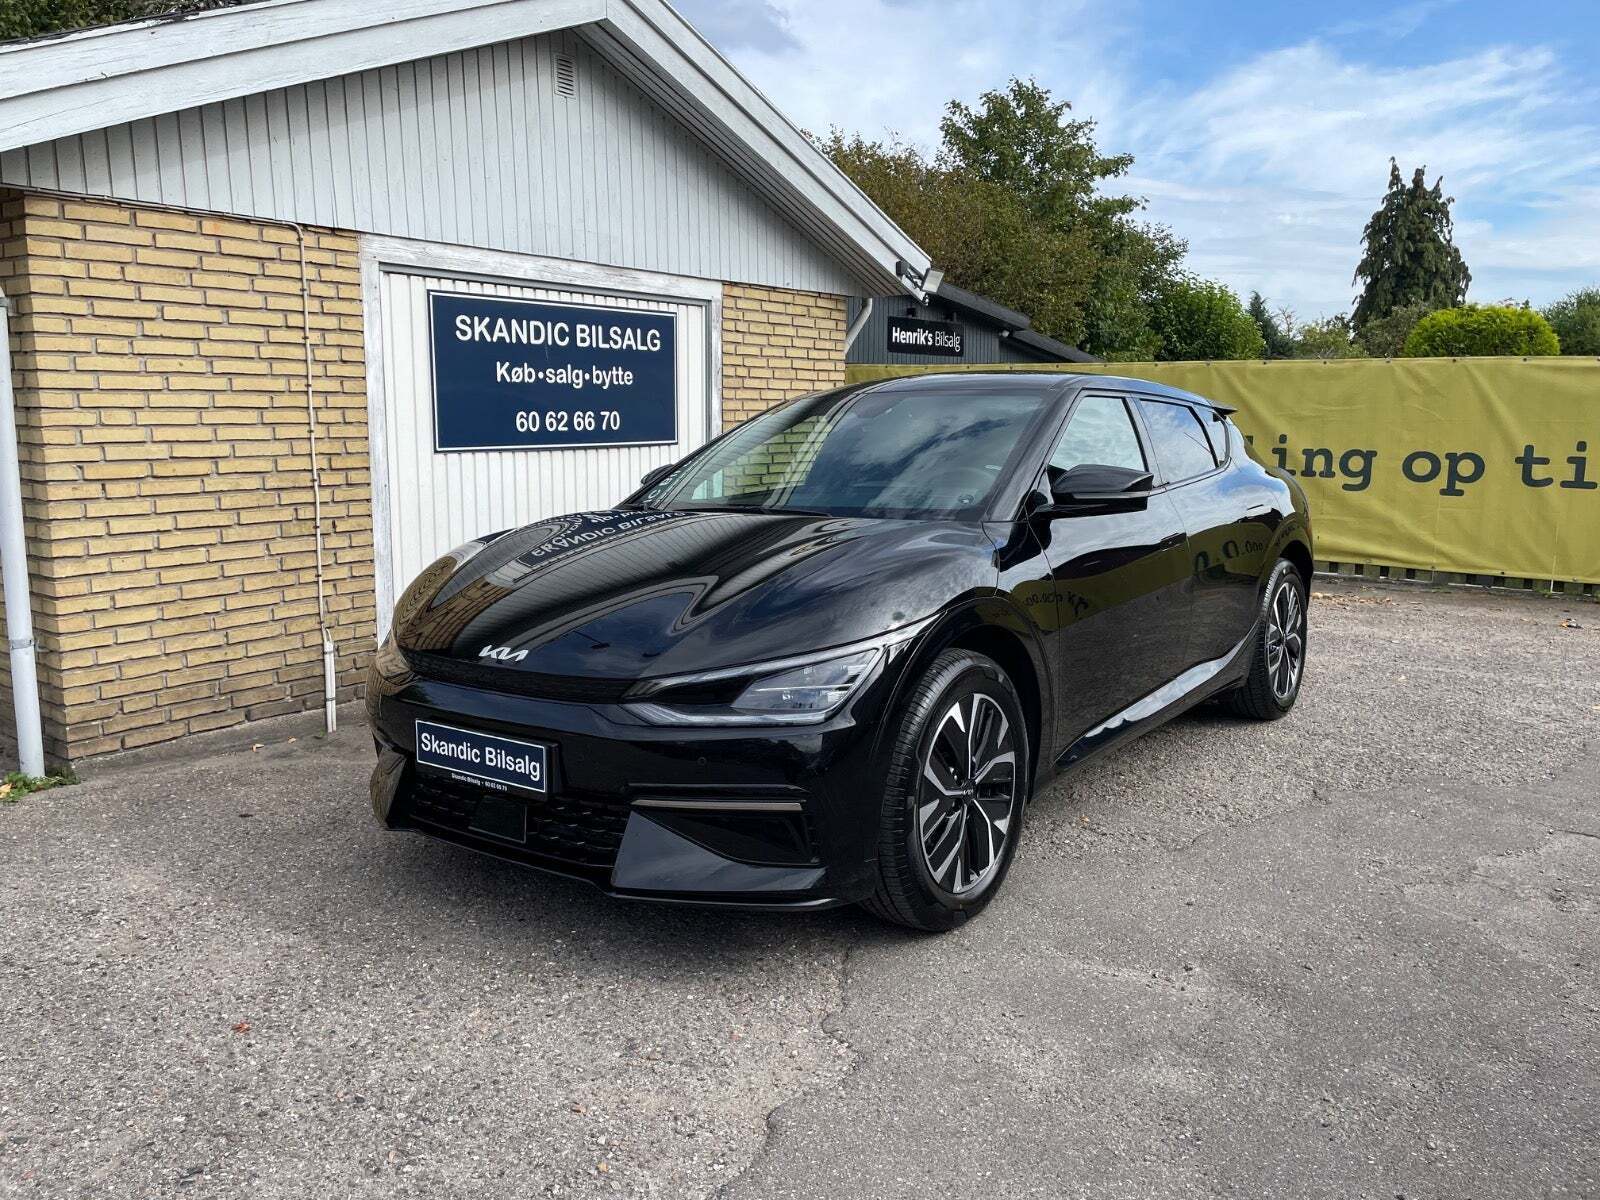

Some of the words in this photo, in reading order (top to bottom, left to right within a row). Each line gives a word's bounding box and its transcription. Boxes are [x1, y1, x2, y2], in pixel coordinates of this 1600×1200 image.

[455, 314, 570, 346] SKANDIC
[576, 324, 661, 352] BILSALG
[892, 326, 933, 346] Henrik's
[934, 330, 961, 352] Bilsalg
[516, 411, 539, 432] 60
[545, 411, 568, 432] 62
[573, 411, 595, 432] 66
[600, 411, 620, 431] 70
[1244, 434, 1378, 492] ing
[1402, 451, 1486, 497] op
[1514, 440, 1598, 490] ti
[479, 644, 529, 661] KIA
[421, 732, 481, 763] Skandic
[485, 747, 540, 782] Bilsalg
